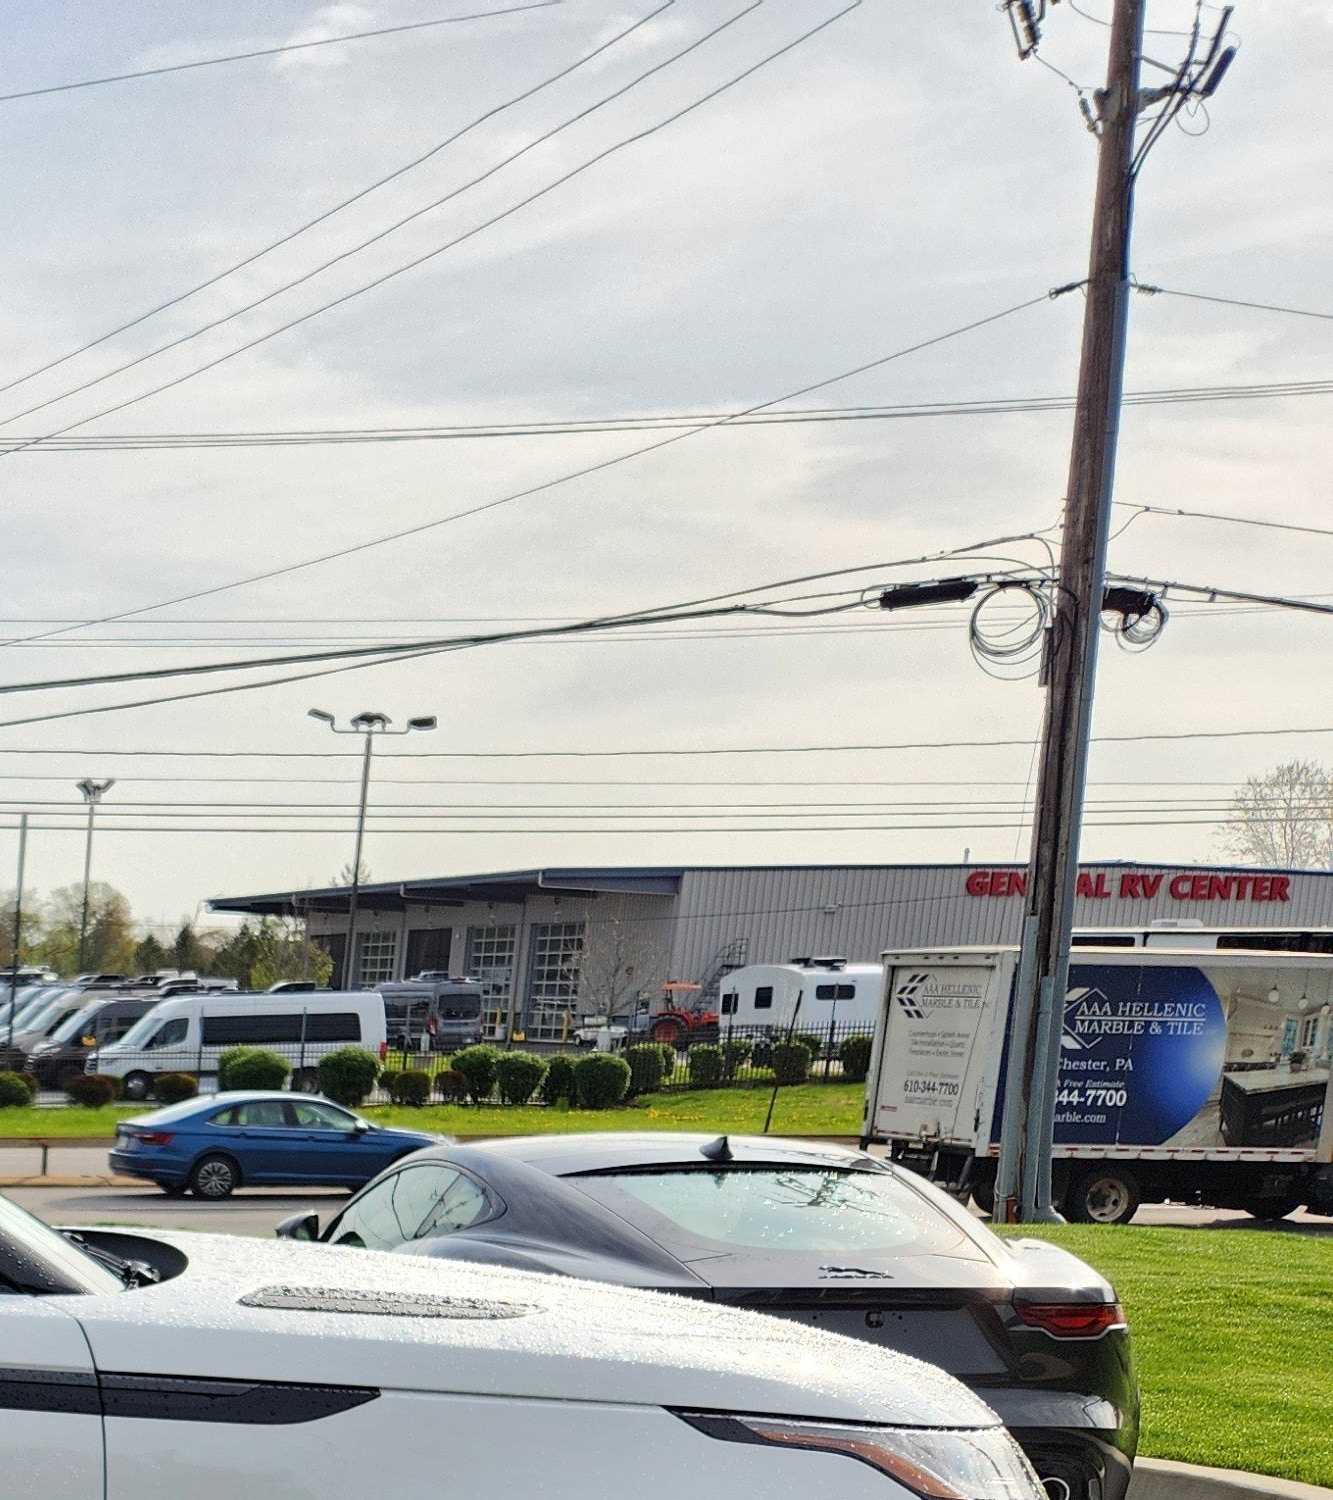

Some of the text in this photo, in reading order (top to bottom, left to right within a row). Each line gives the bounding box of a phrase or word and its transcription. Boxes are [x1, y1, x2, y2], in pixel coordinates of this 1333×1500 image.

[966, 871, 1291, 902] GENAL RV CENTER
[1076, 1001, 1206, 1017] AAA HELLENIC
[1074, 1020, 1204, 1035] MARBLE & TILE
[1115, 1058, 1134, 1071] PA
[903, 1079, 959, 1096] 610-344-7700
[1063, 1079, 1083, 1088] Free
[1085, 1078, 1125, 1088] Estimate
